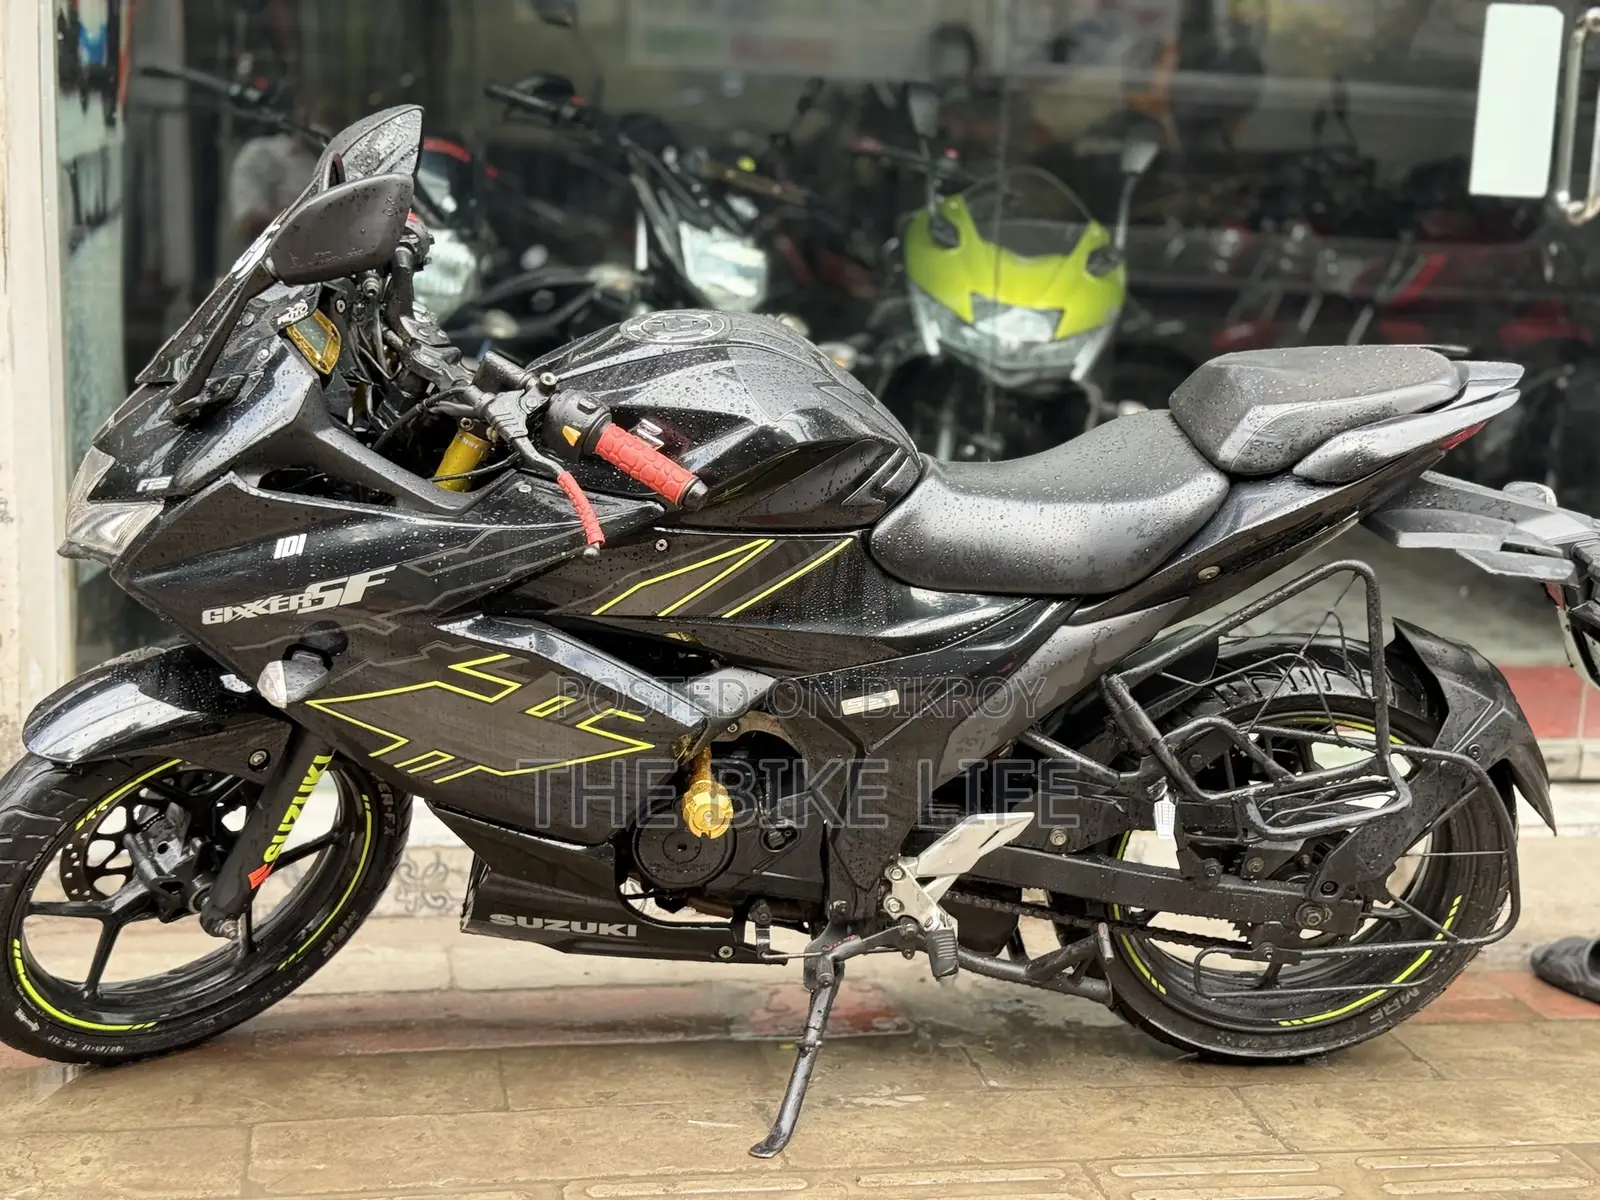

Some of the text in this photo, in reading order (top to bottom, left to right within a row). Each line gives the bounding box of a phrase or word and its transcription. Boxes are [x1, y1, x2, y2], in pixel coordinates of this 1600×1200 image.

[201, 565, 398, 625] GIXXER SF
[322, 910, 360, 957] MRF
[489, 913, 638, 937] SUZUKI
[1369, 986, 1420, 1025] MRF
